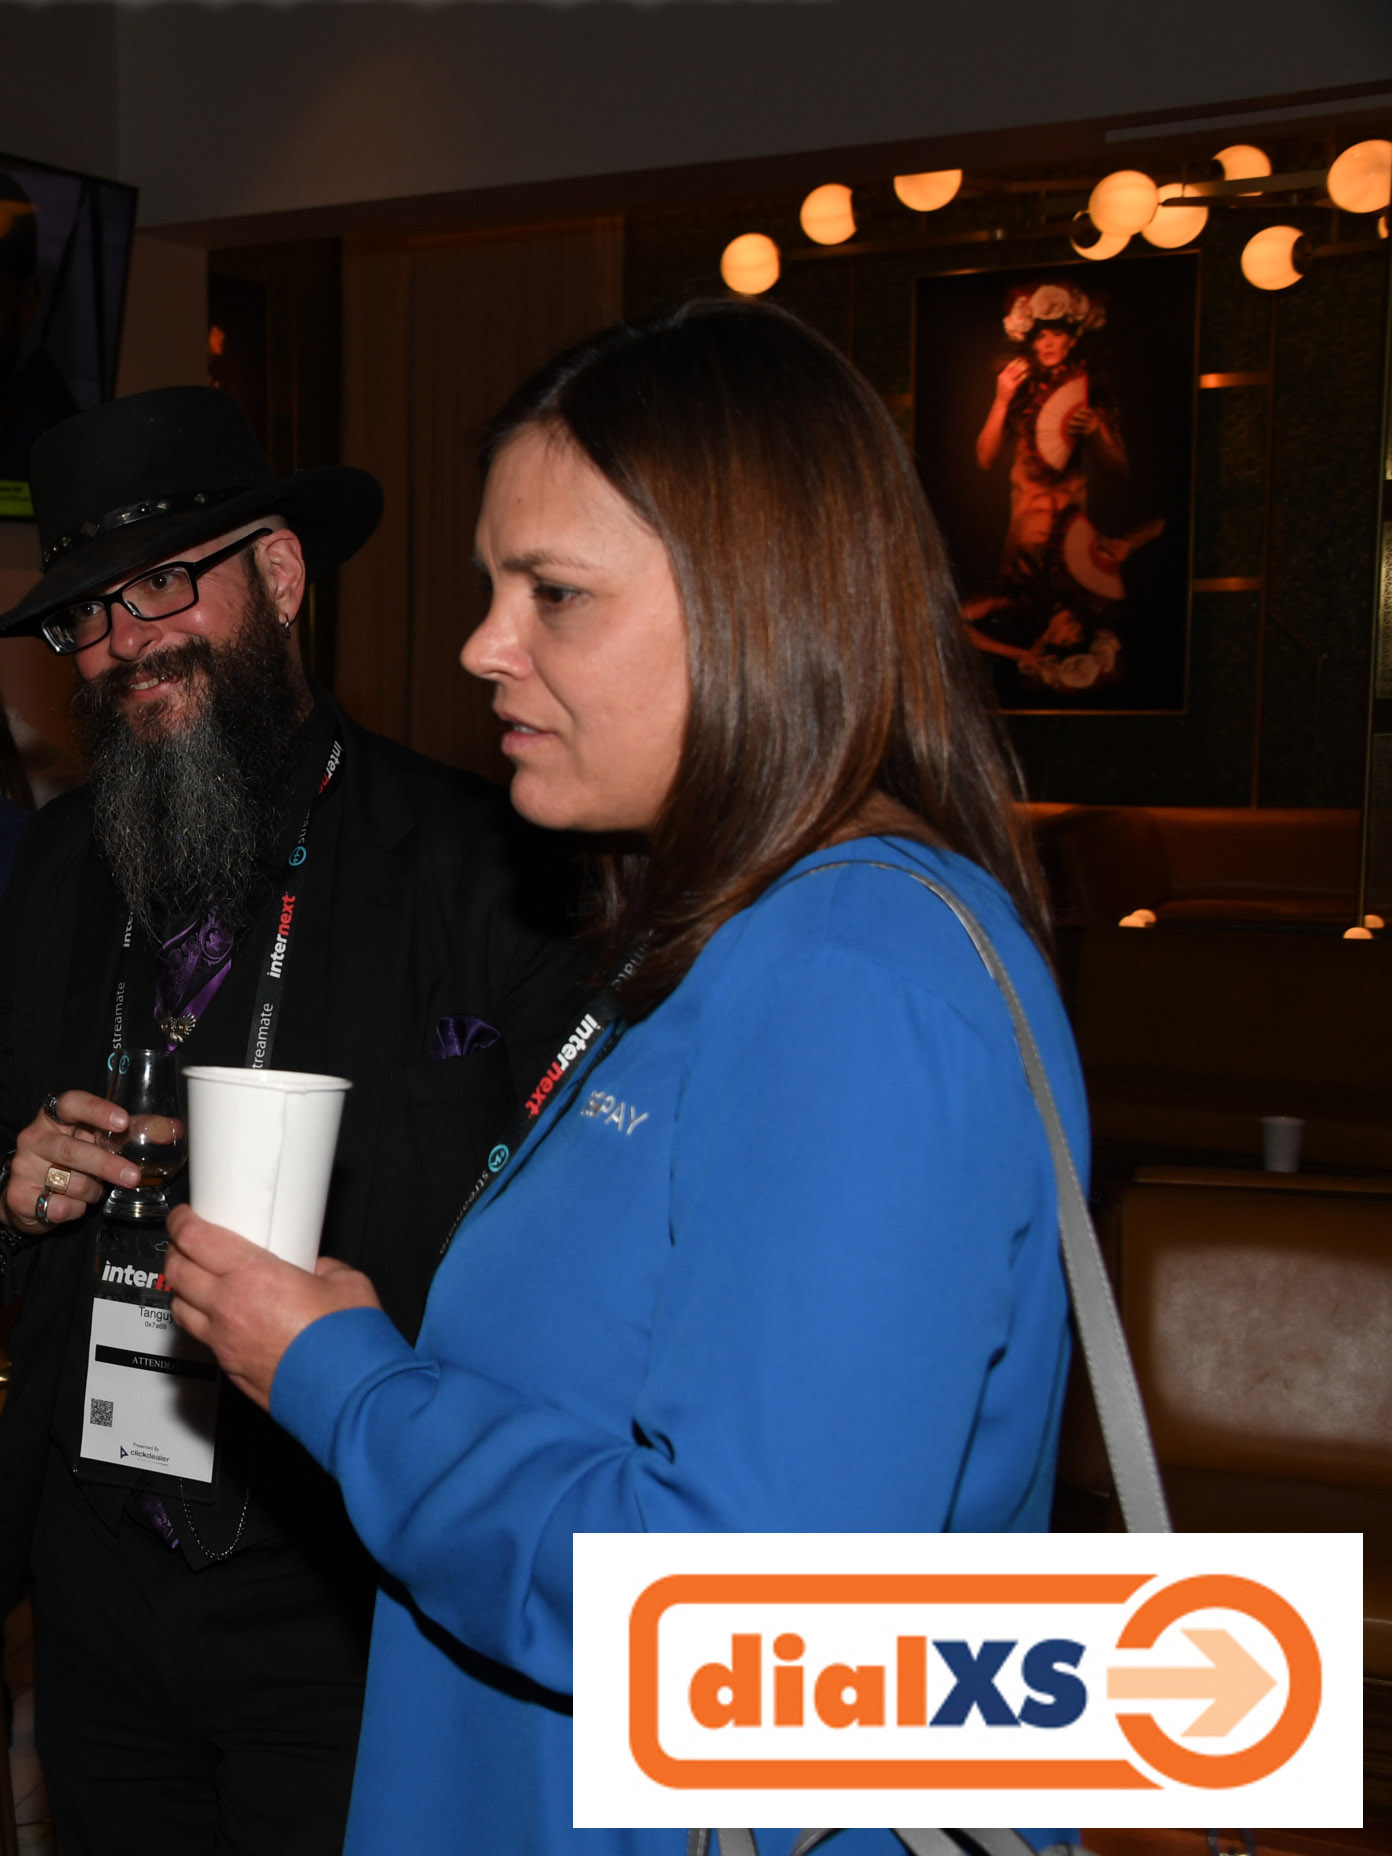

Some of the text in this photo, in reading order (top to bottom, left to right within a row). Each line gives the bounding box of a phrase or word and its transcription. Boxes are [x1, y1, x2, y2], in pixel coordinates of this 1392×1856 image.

[266, 891, 297, 979] internext
[113, 981, 127, 1050] streamate
[251, 1002, 274, 1070] treamate
[525, 1013, 603, 1119] internext
[130, 1450, 170, 1463] clickdealer
